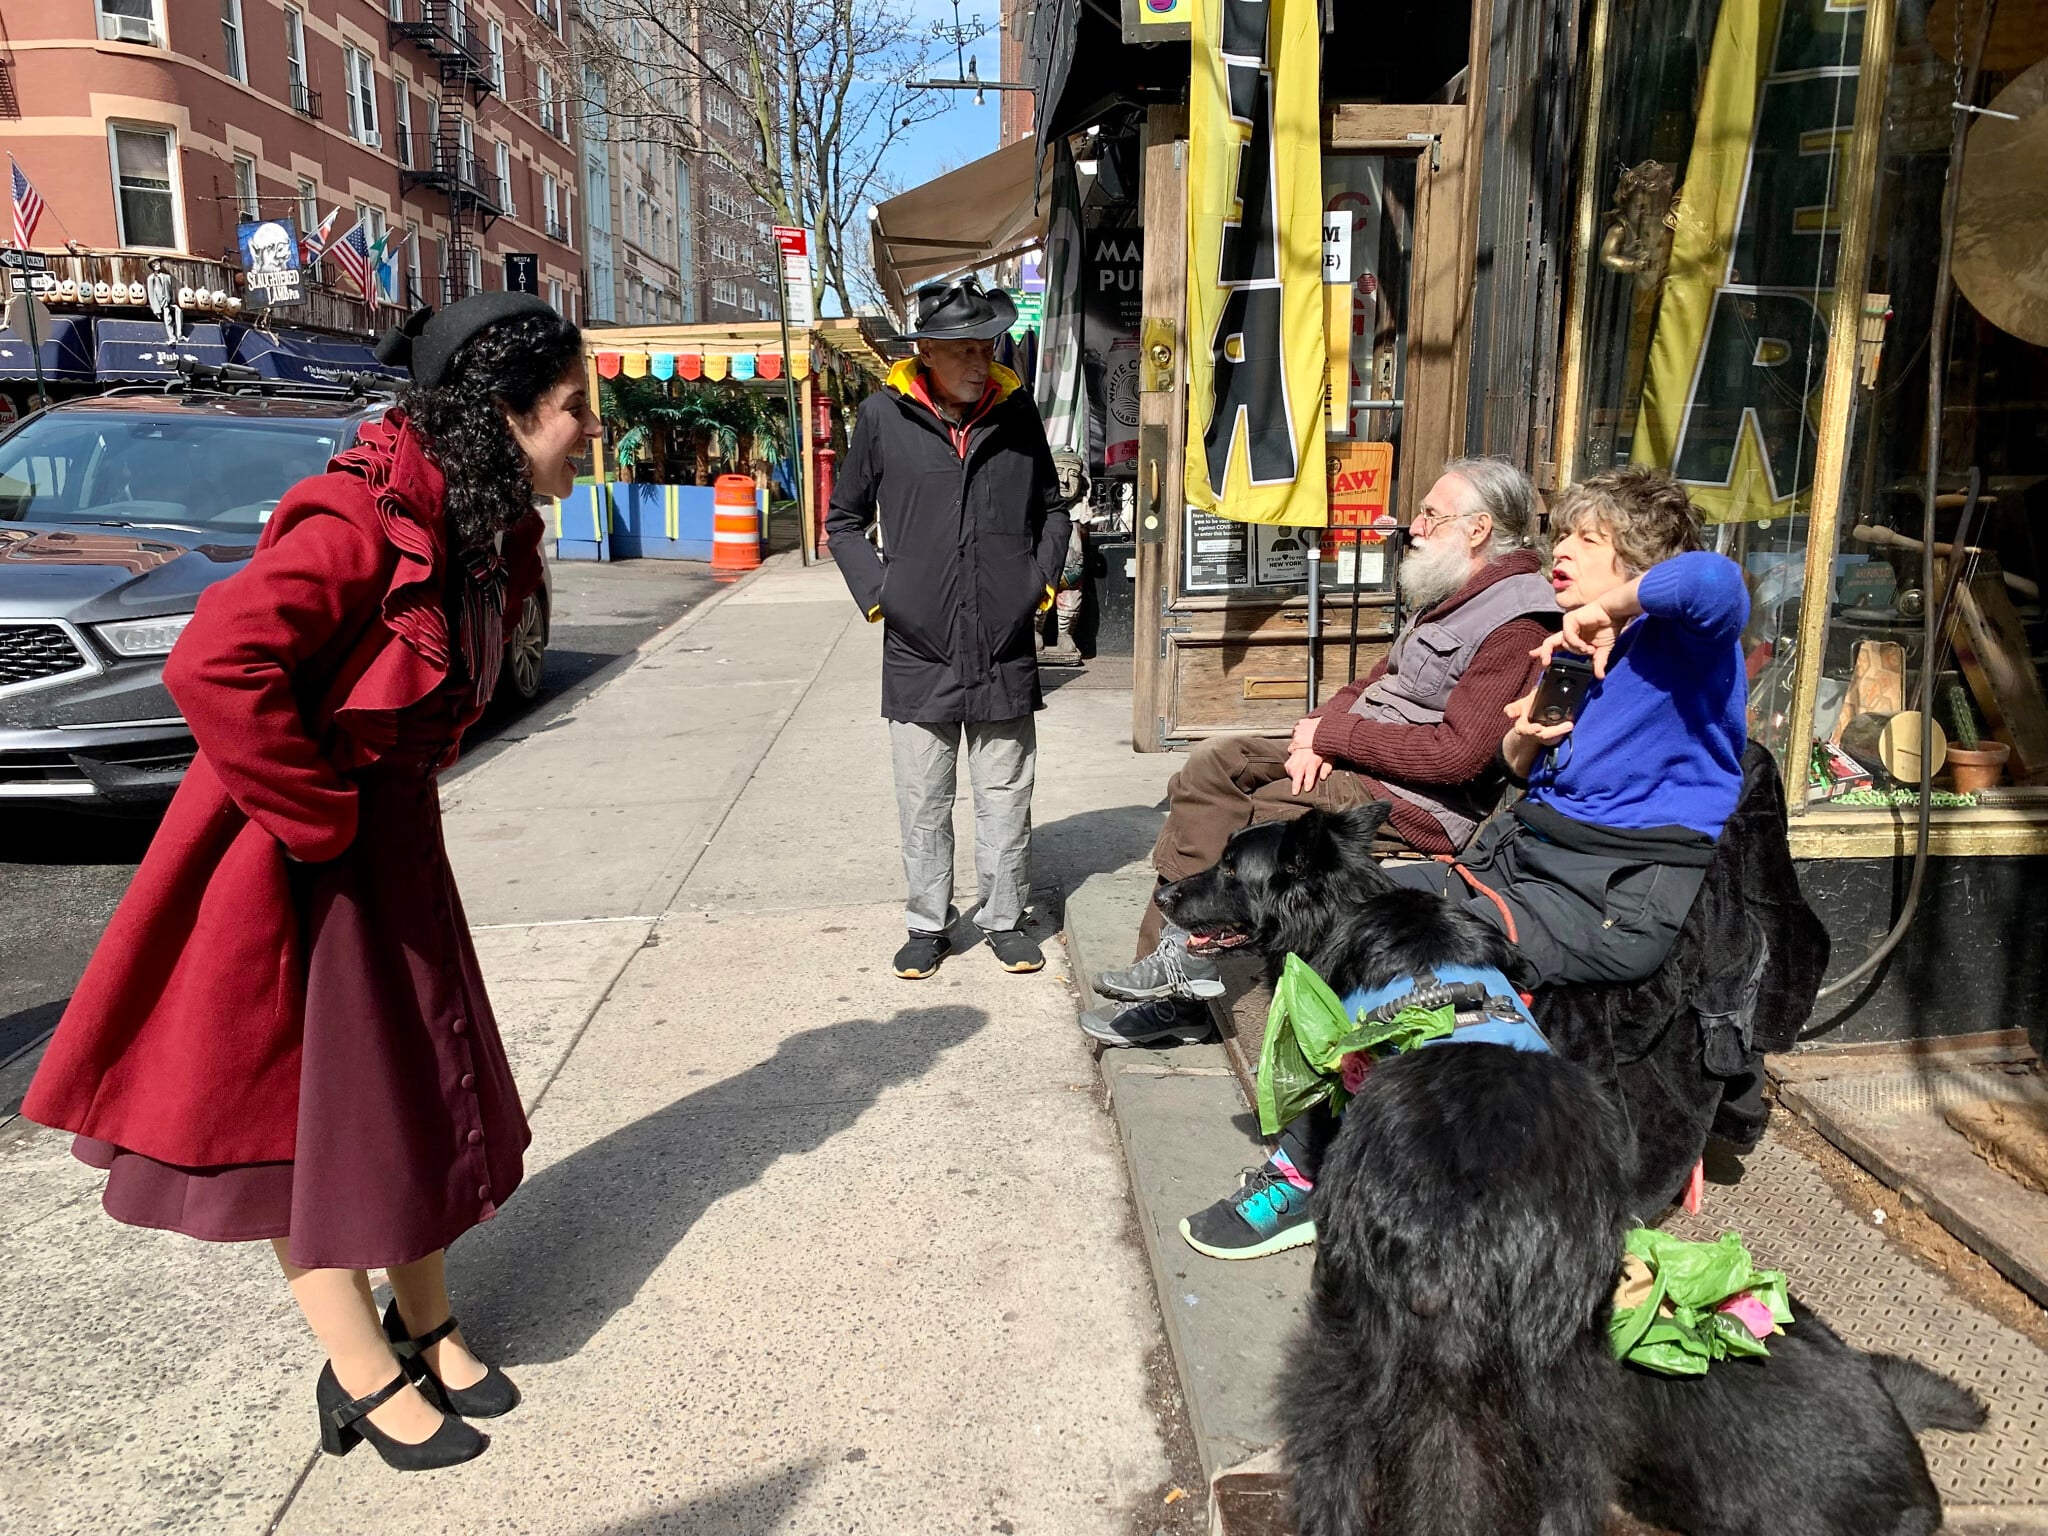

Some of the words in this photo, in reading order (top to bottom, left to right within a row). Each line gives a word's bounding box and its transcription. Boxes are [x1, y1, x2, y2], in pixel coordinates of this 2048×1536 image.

[5, 253, 21, 265] ONE
[27, 256, 42, 266] WAY
[1099, 269, 1143, 291] PU
[156, 351, 180, 365] Pub
[1455, 1013, 1479, 1024] DOG
